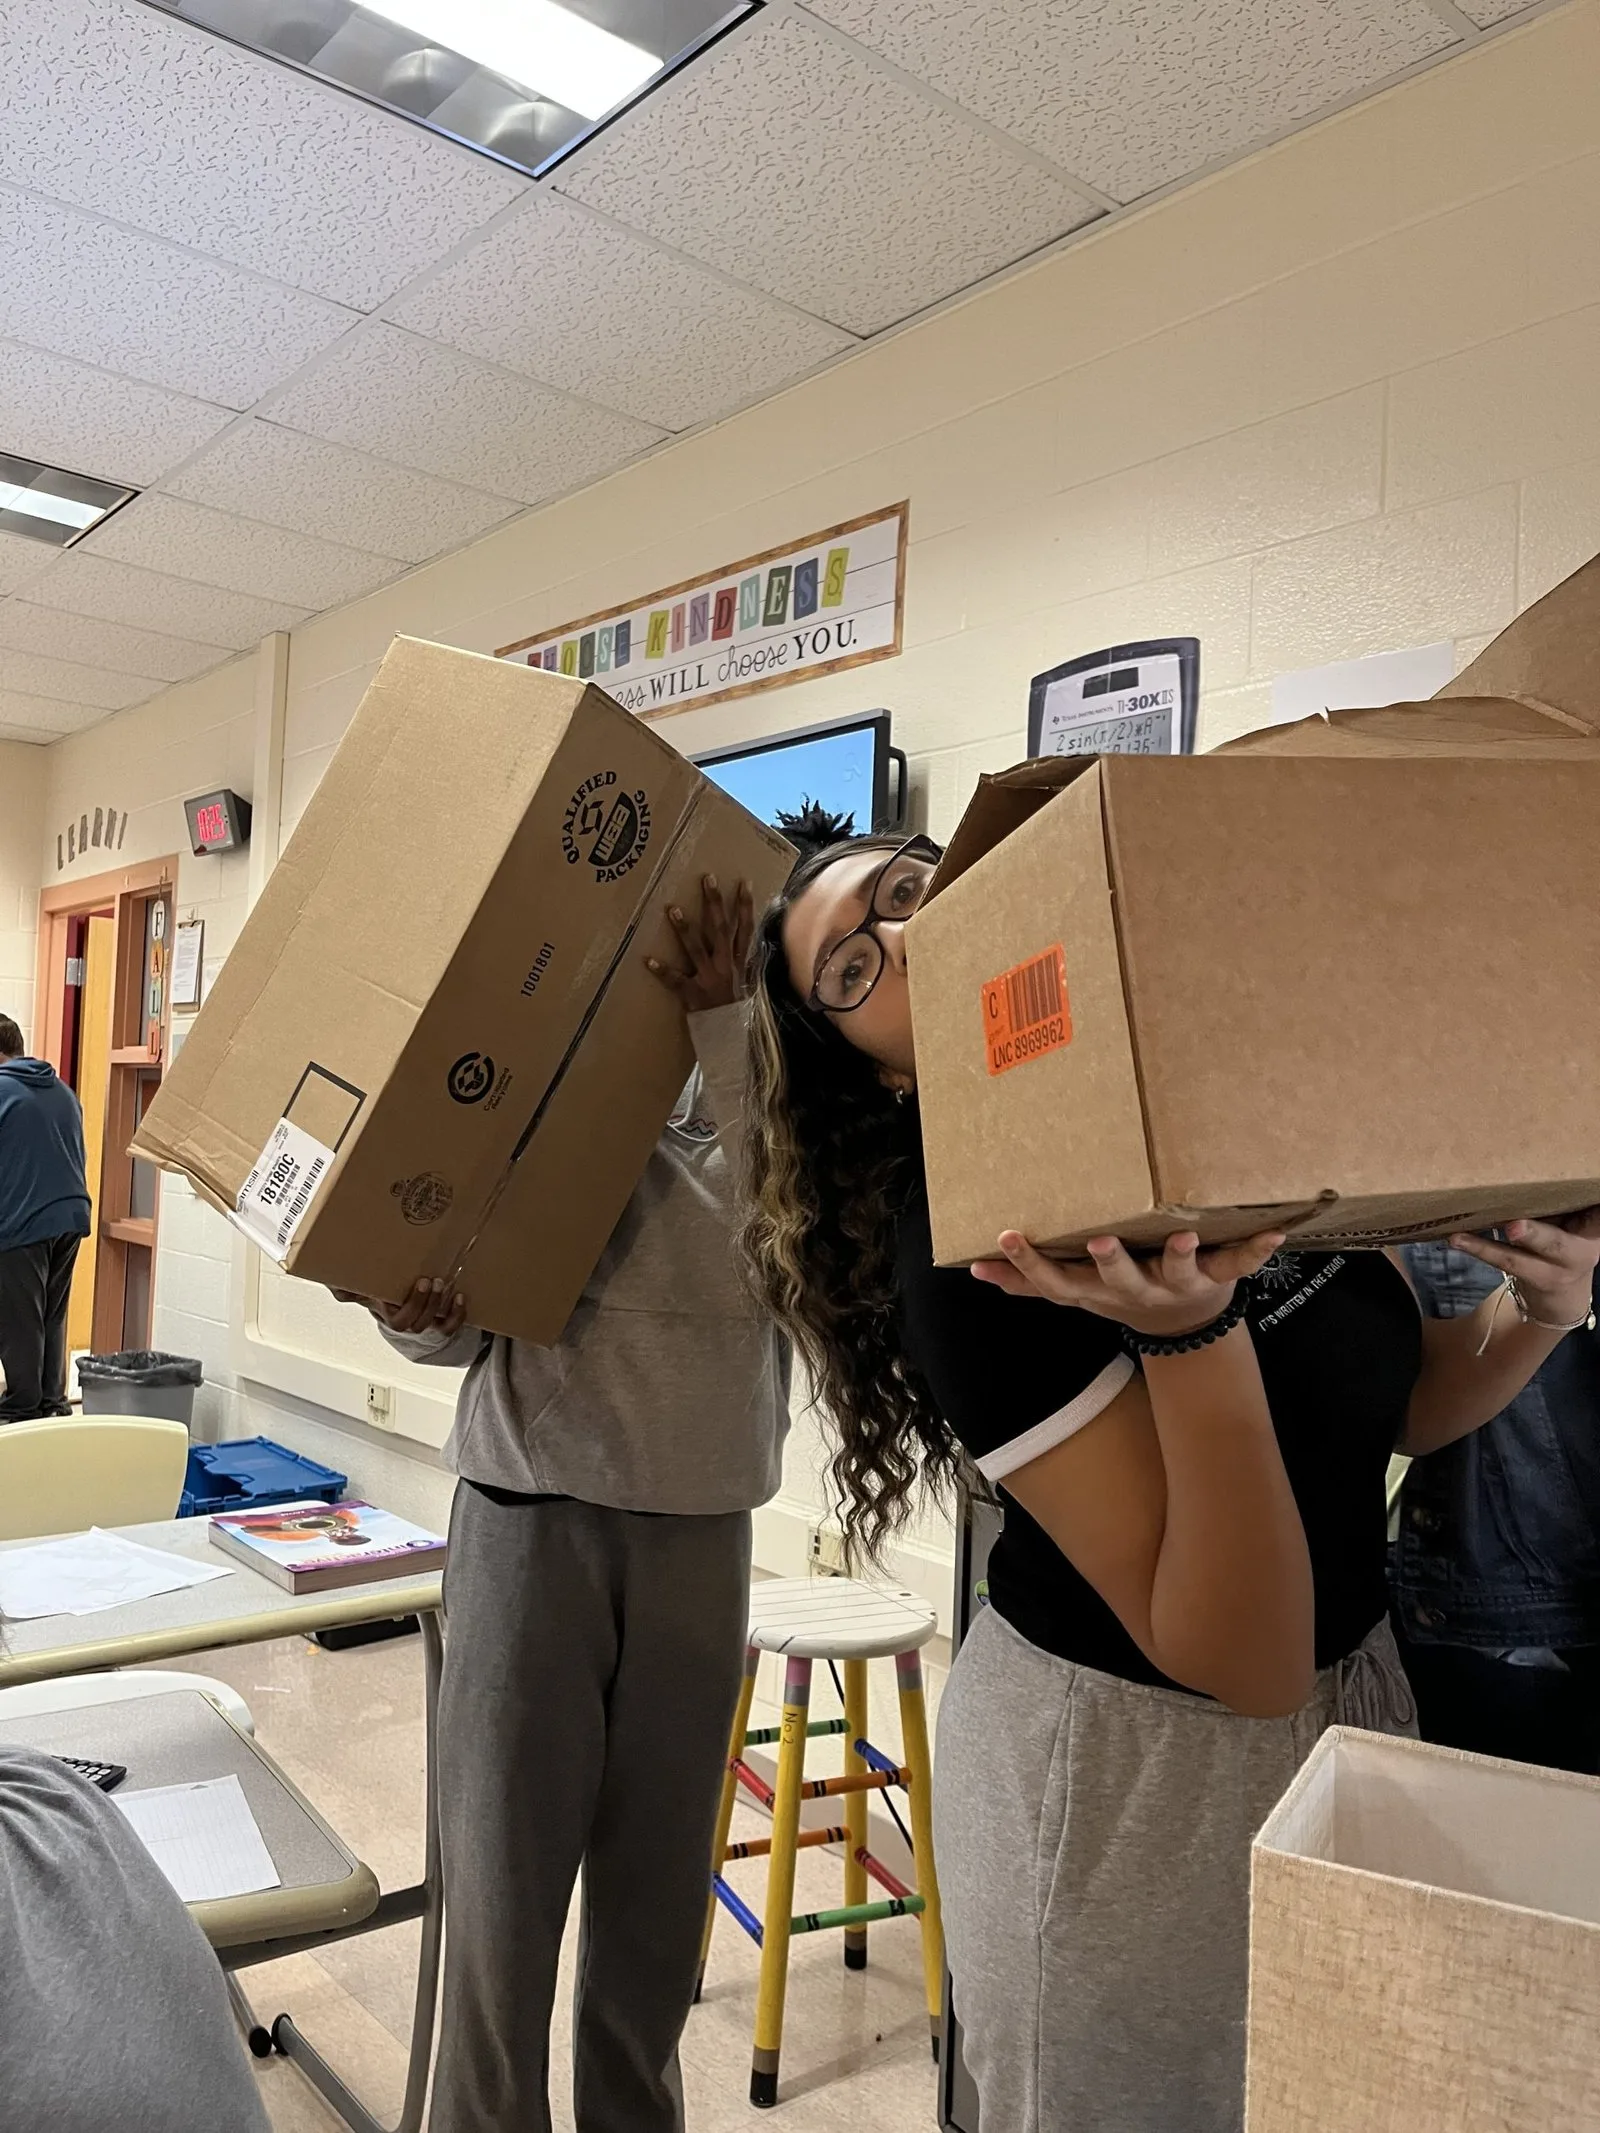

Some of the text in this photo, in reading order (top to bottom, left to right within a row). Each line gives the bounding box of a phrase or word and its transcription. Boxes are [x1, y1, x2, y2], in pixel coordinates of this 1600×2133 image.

[647, 552, 847, 656] KINDNESS
[649, 664, 710, 701] WILL
[717, 641, 788, 682] choose
[793, 619, 859, 661] YOU.
[562, 771, 617, 864] QUALIFIED
[595, 789, 651, 883] PACKAGING
[520, 942, 556, 999] 1001801
[988, 991, 999, 1019] C
[993, 1041, 1014, 1069] LNC
[1015, 1017, 1065, 1060] 8969962
[260, 1153, 295, 1205] 18180C
[1258, 1254, 1346, 1332] IT'S WRITTEN IN THE STARS
